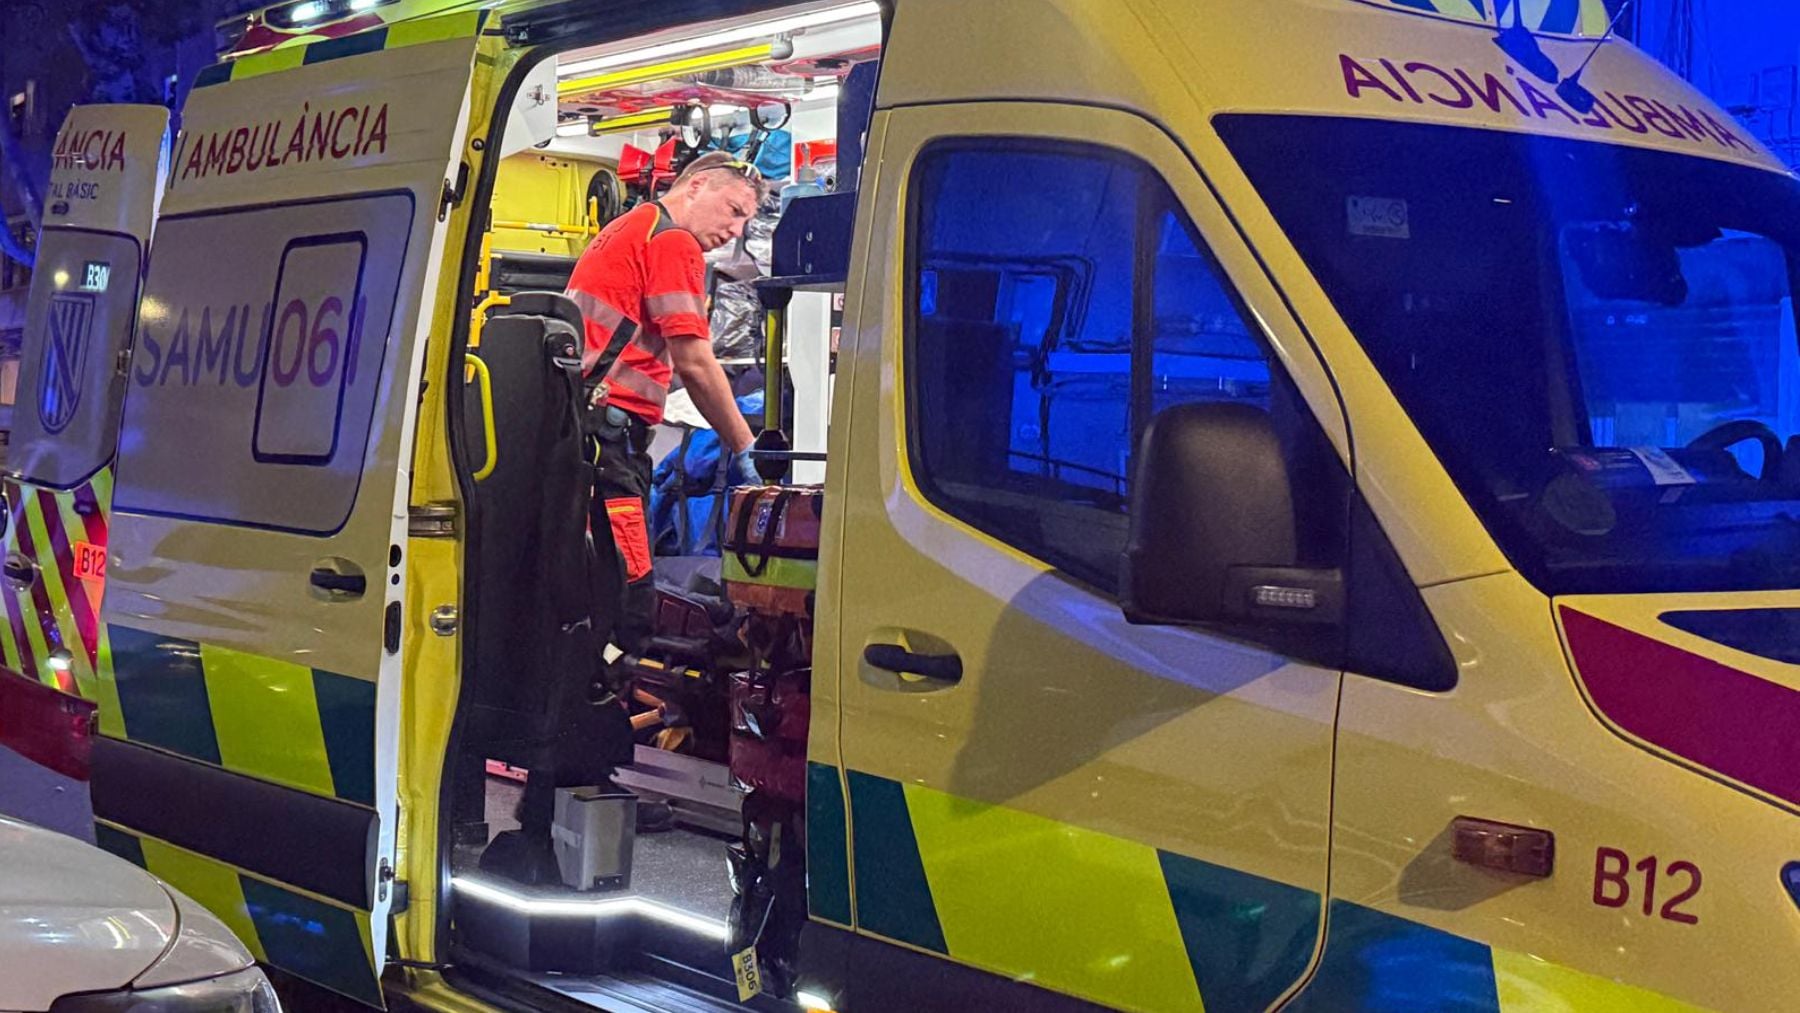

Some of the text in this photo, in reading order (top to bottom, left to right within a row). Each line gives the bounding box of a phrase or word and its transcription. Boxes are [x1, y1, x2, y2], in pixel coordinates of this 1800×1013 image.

[181, 101, 389, 180] AMBULÀNCIA
[86, 263, 111, 292] B30
[81, 547, 107, 578] B12
[1592, 845, 1703, 925] B12
[742, 953, 759, 991] B306
